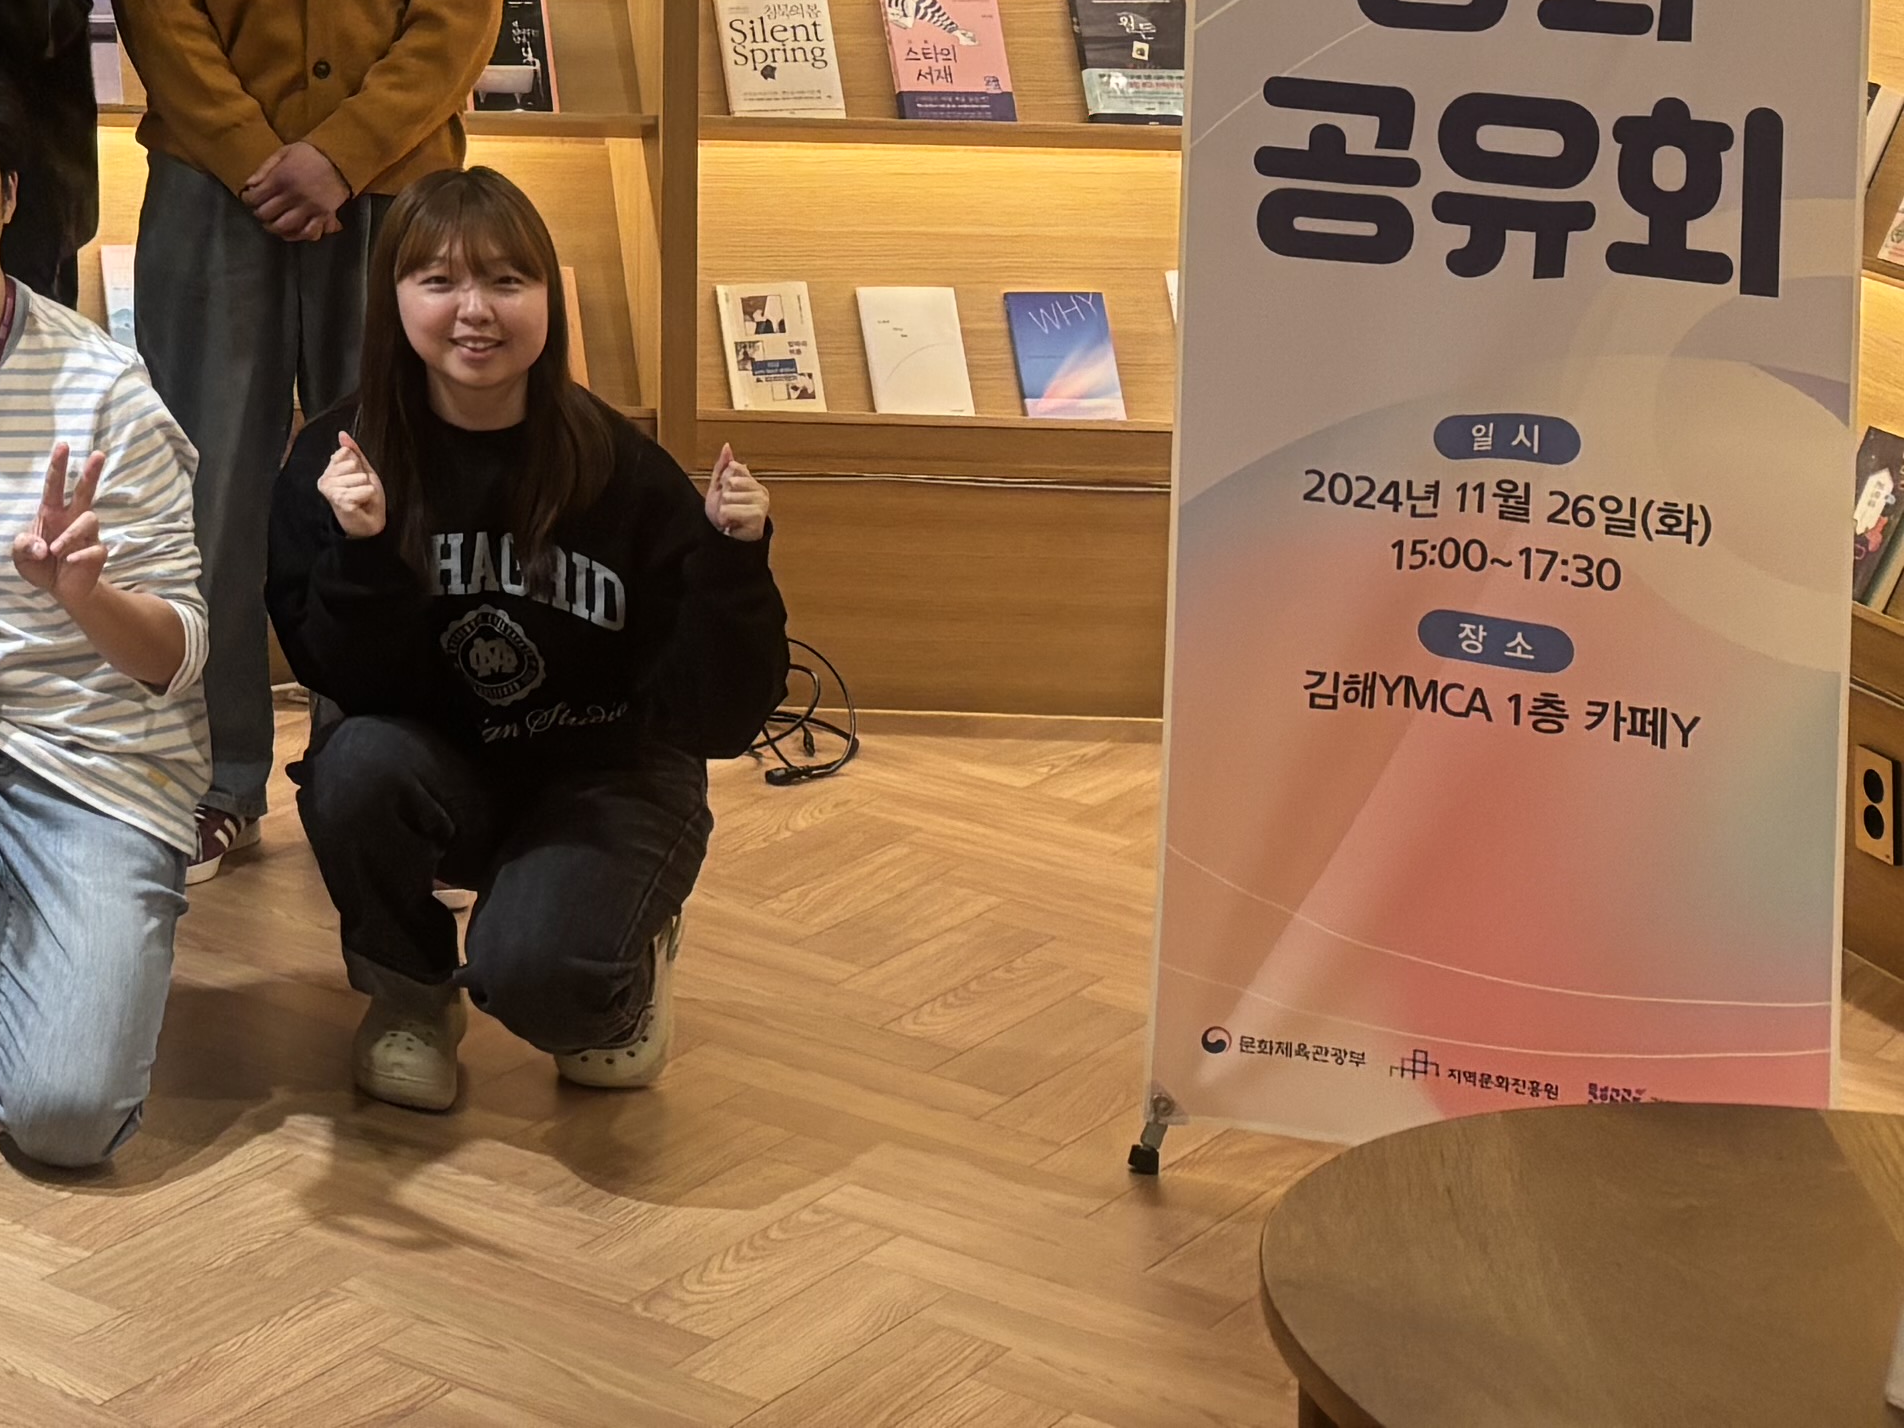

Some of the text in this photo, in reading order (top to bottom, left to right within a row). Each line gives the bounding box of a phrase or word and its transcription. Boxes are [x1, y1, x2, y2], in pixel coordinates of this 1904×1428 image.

[728, 16, 825, 45] Silent
[733, 44, 828, 70] Spring
[904, 45, 958, 63] 스타의
[917, 68, 953, 84] 서재
[1254, 75, 1784, 298] 공유회
[1028, 293, 1098, 334] WHY
[1302, 469, 1712, 546] 2024년 11월 26일(화)
[1390, 539, 1622, 591] 15:00~17:30
[1302, 669, 1702, 750] 김해YMCA 1층 카페Y
[1239, 1034, 1366, 1068] 문화체육관광부
[1447, 1068, 1559, 1101] 지역문화진흥원
